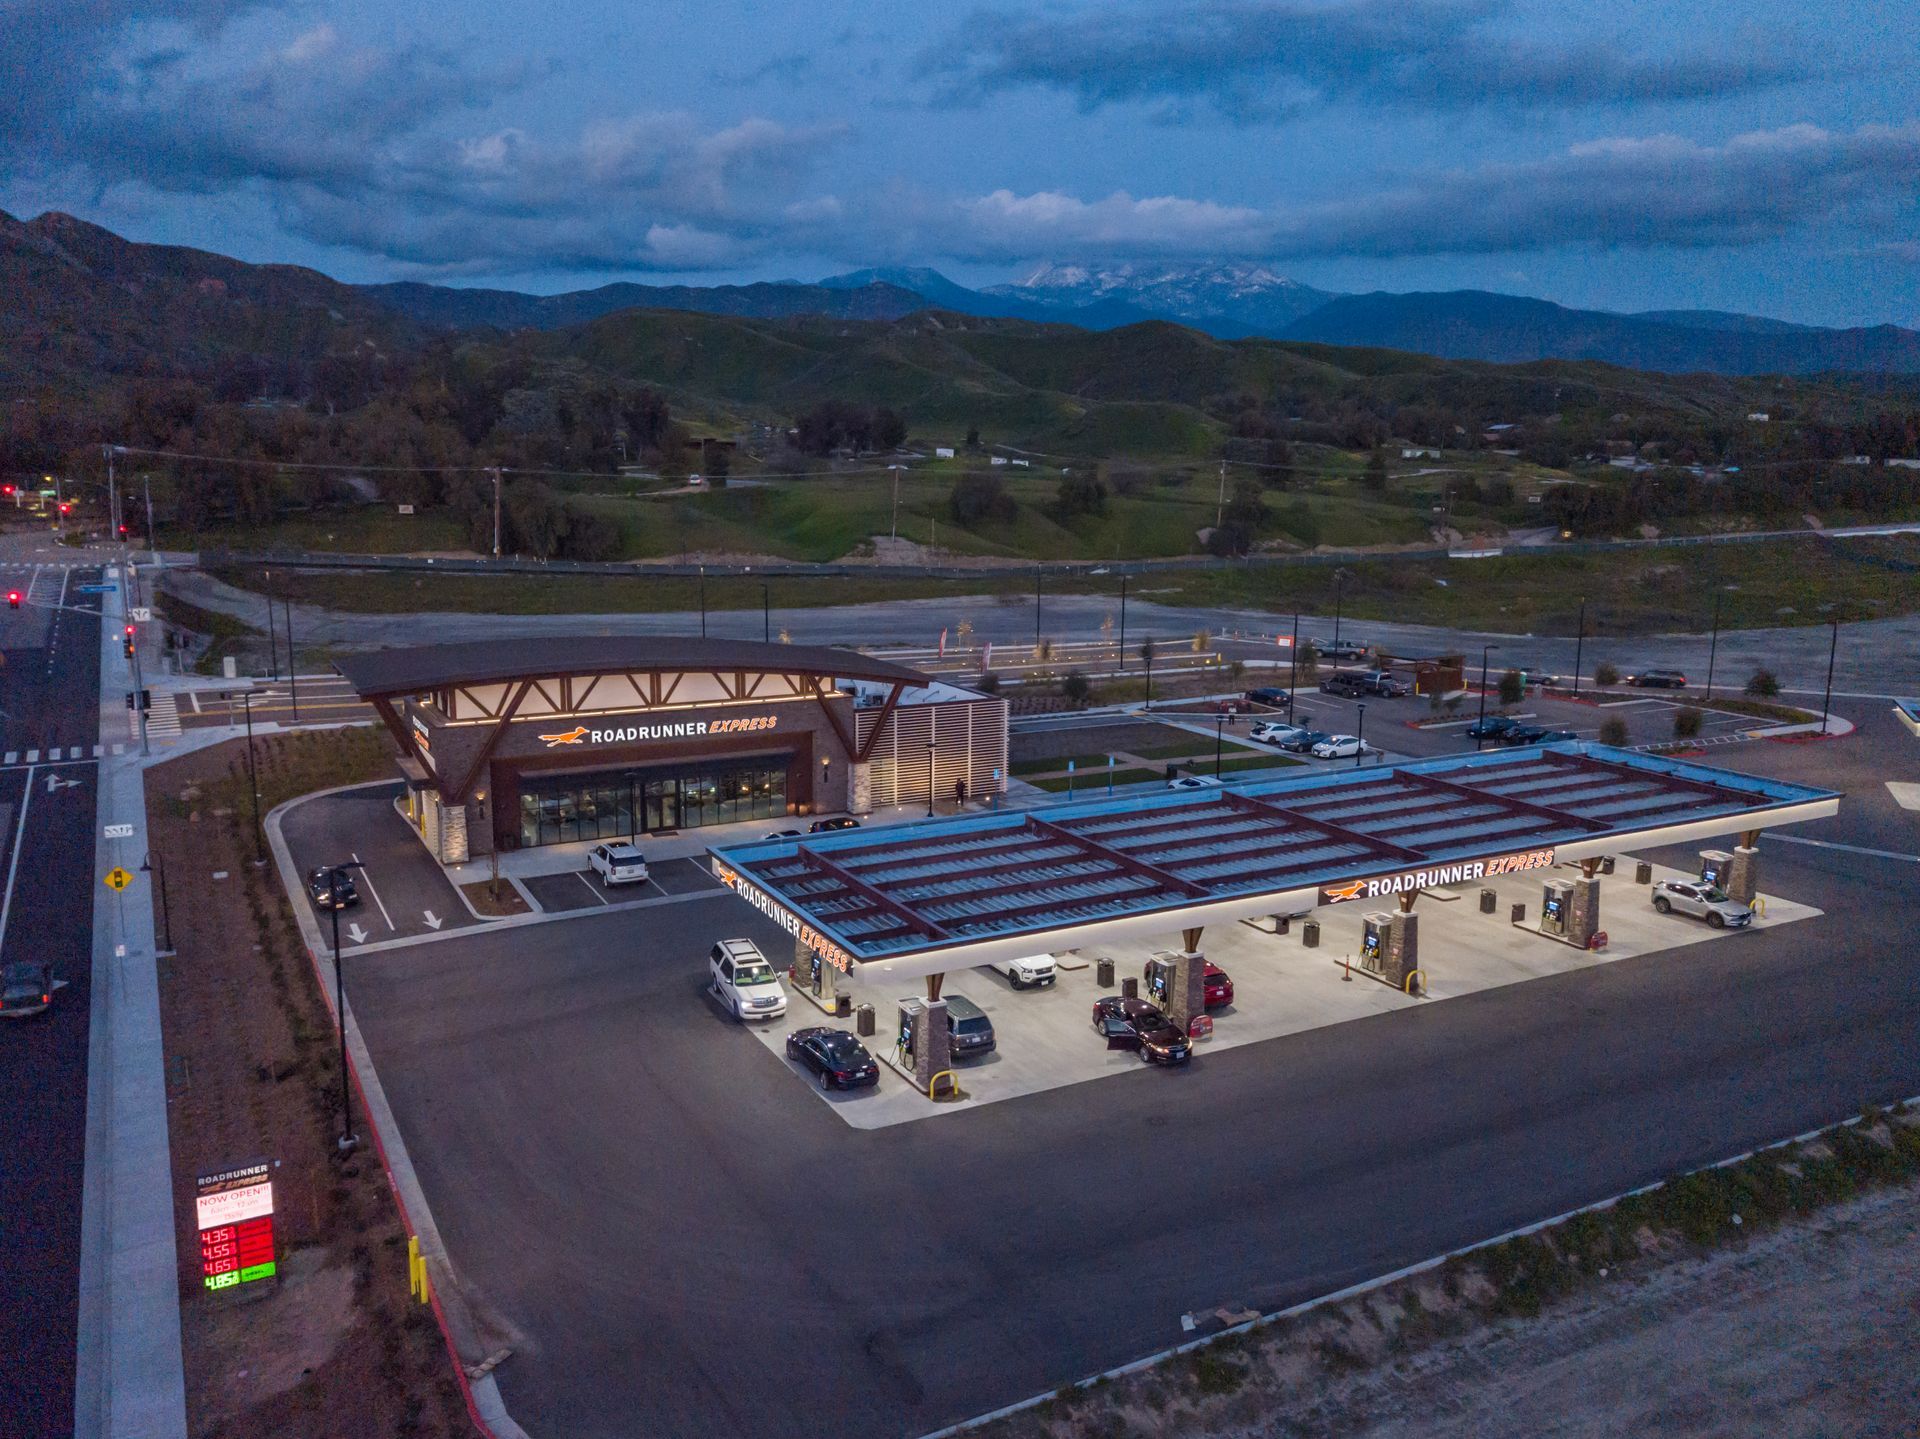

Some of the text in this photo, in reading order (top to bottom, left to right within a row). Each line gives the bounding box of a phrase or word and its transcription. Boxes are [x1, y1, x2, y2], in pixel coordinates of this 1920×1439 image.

[590, 716, 778, 744] ROADRUNNER EXPRESS
[1368, 850, 1554, 898] ROADRUNNER EXPRESS
[737, 878, 848, 973] ROADRUNNER EXPRESS
[198, 1165, 268, 1185] ROADRUNNER
[200, 1195, 228, 1207] NOW
